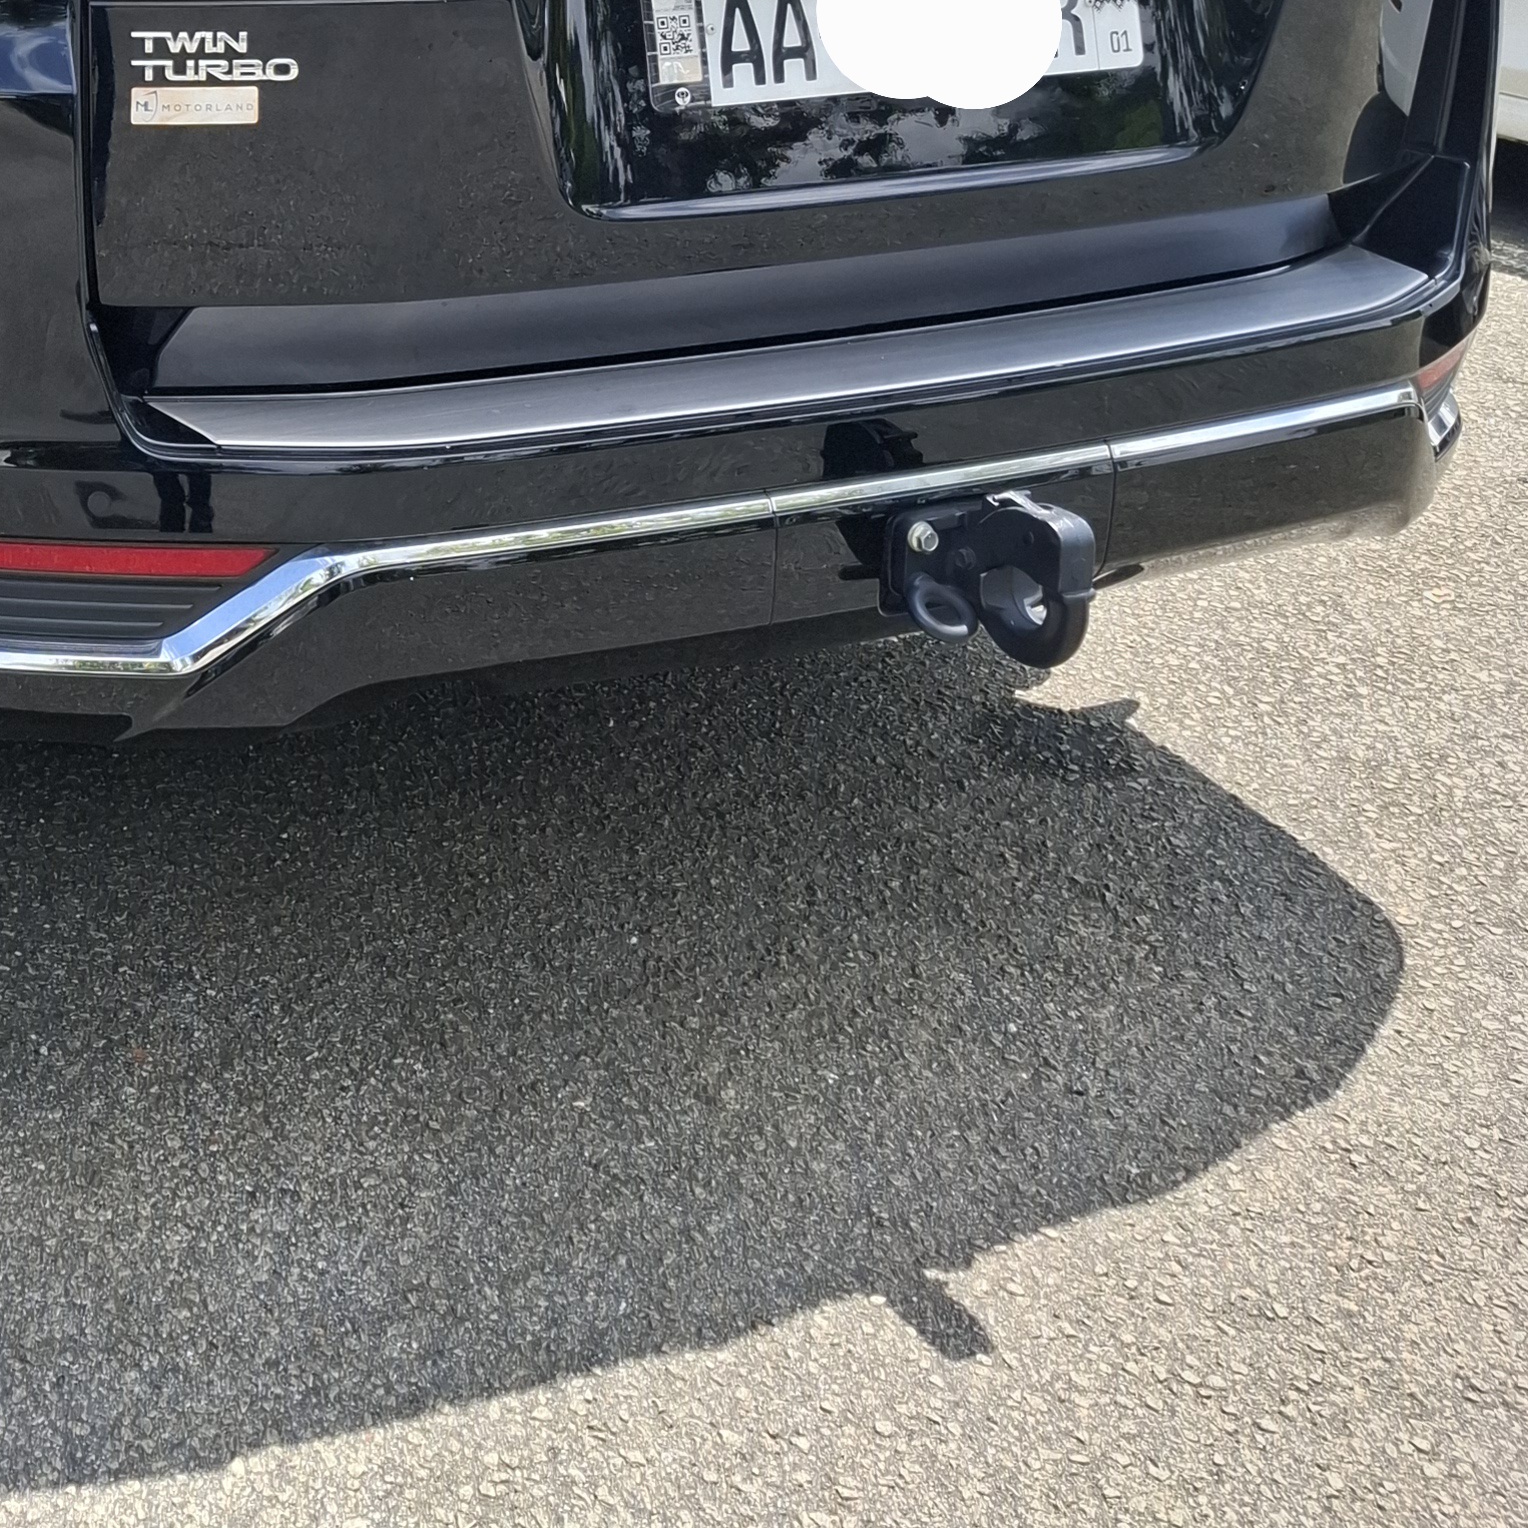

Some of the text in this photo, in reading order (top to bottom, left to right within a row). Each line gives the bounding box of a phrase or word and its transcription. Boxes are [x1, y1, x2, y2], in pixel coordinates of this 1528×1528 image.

[130, 31, 248, 54] TWIN
[1109, 29, 1133, 54] 01
[130, 57, 299, 82] TURBO
[161, 103, 255, 113] MOTORLAND
